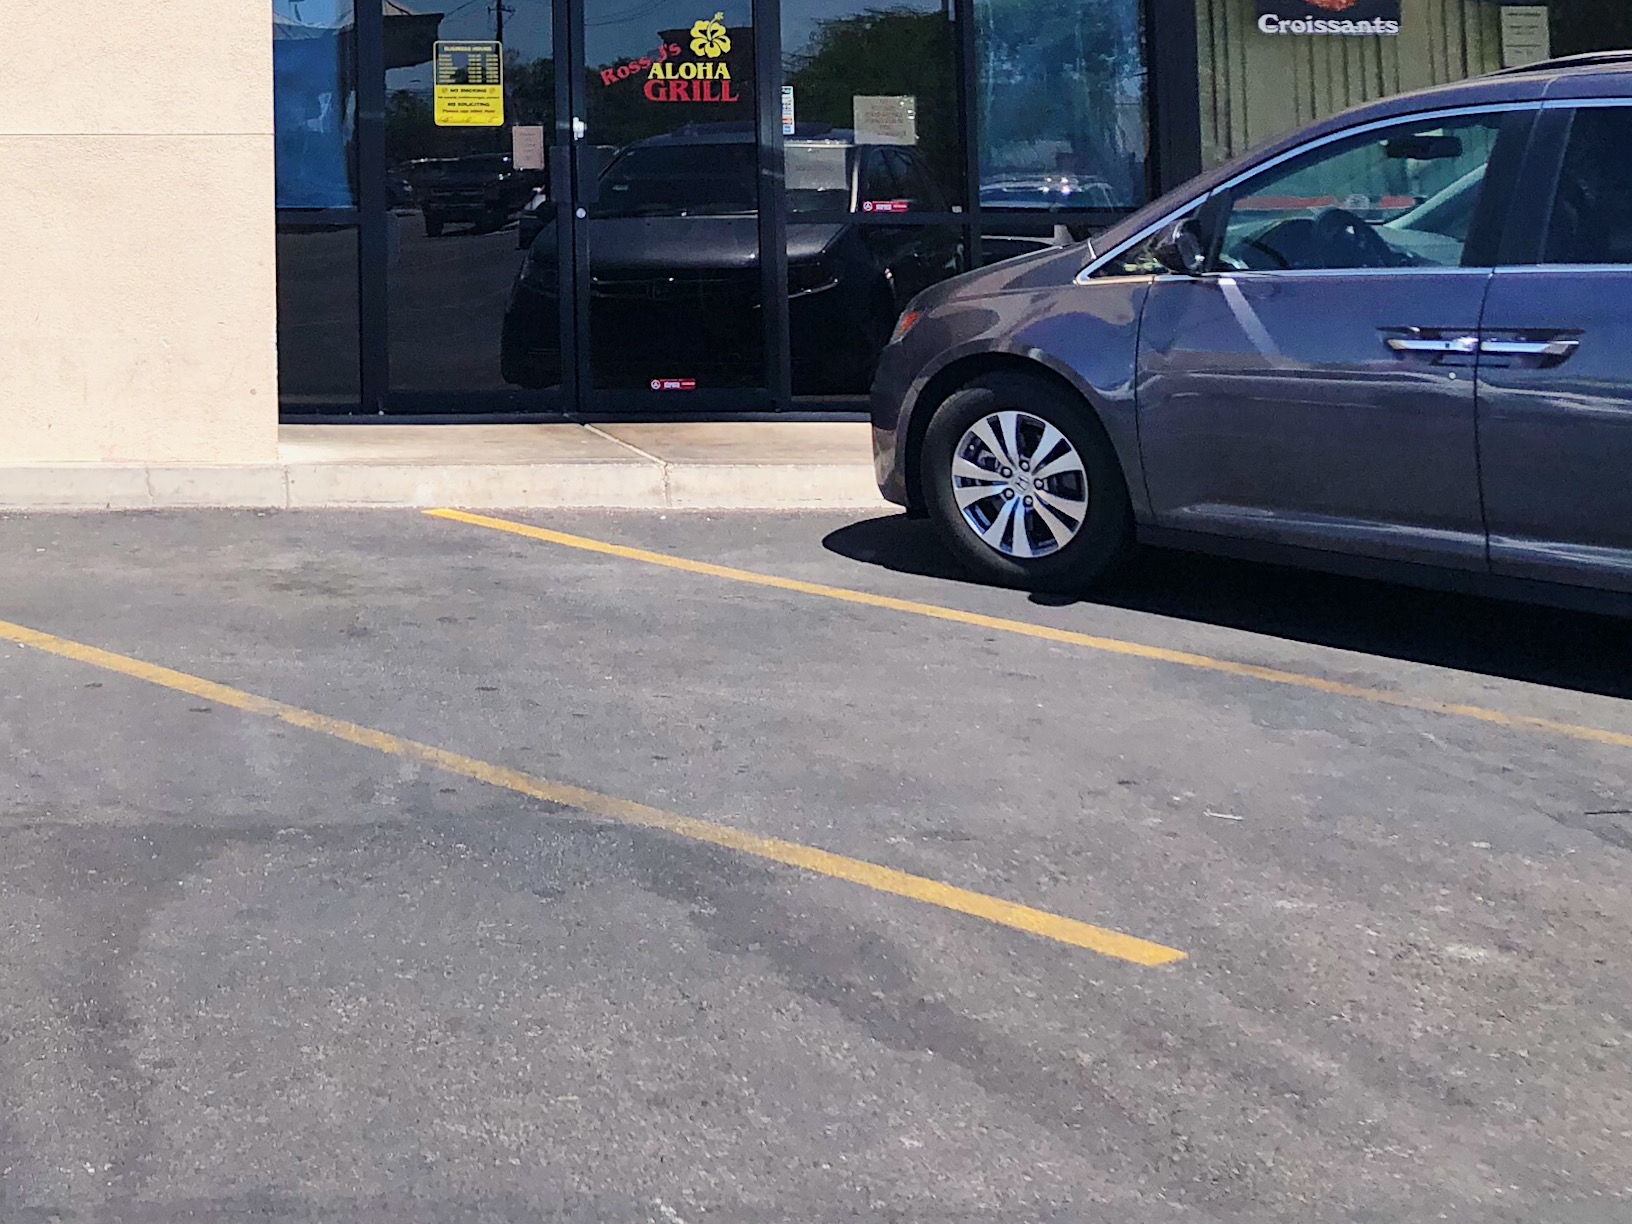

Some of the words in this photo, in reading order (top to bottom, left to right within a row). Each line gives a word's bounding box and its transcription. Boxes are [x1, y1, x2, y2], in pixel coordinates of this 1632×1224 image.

[1257, 13, 1400, 35] Croissants
[600, 56, 652, 86] Ross
[657, 42, 682, 64] J's
[647, 62, 731, 80] ALOHA
[643, 79, 739, 102] GRILL
